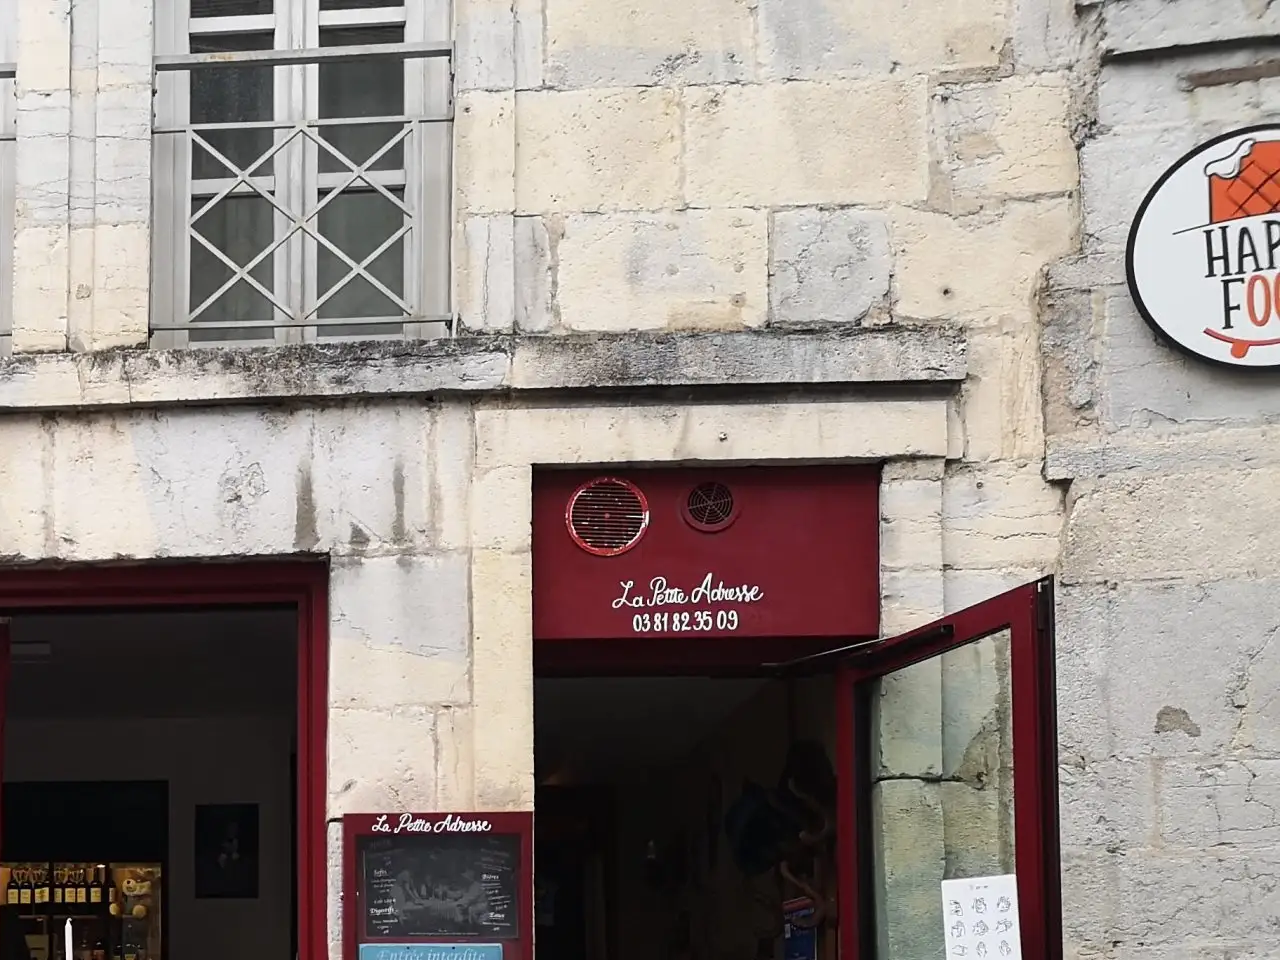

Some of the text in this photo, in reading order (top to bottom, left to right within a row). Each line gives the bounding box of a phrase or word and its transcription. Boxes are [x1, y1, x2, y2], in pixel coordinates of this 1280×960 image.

[1221, 273, 1280, 330] FO
[612, 572, 764, 608] La Petite Adresse
[632, 610, 739, 632] 03 81 82 35 09
[371, 812, 492, 833] La Petite Adresse
